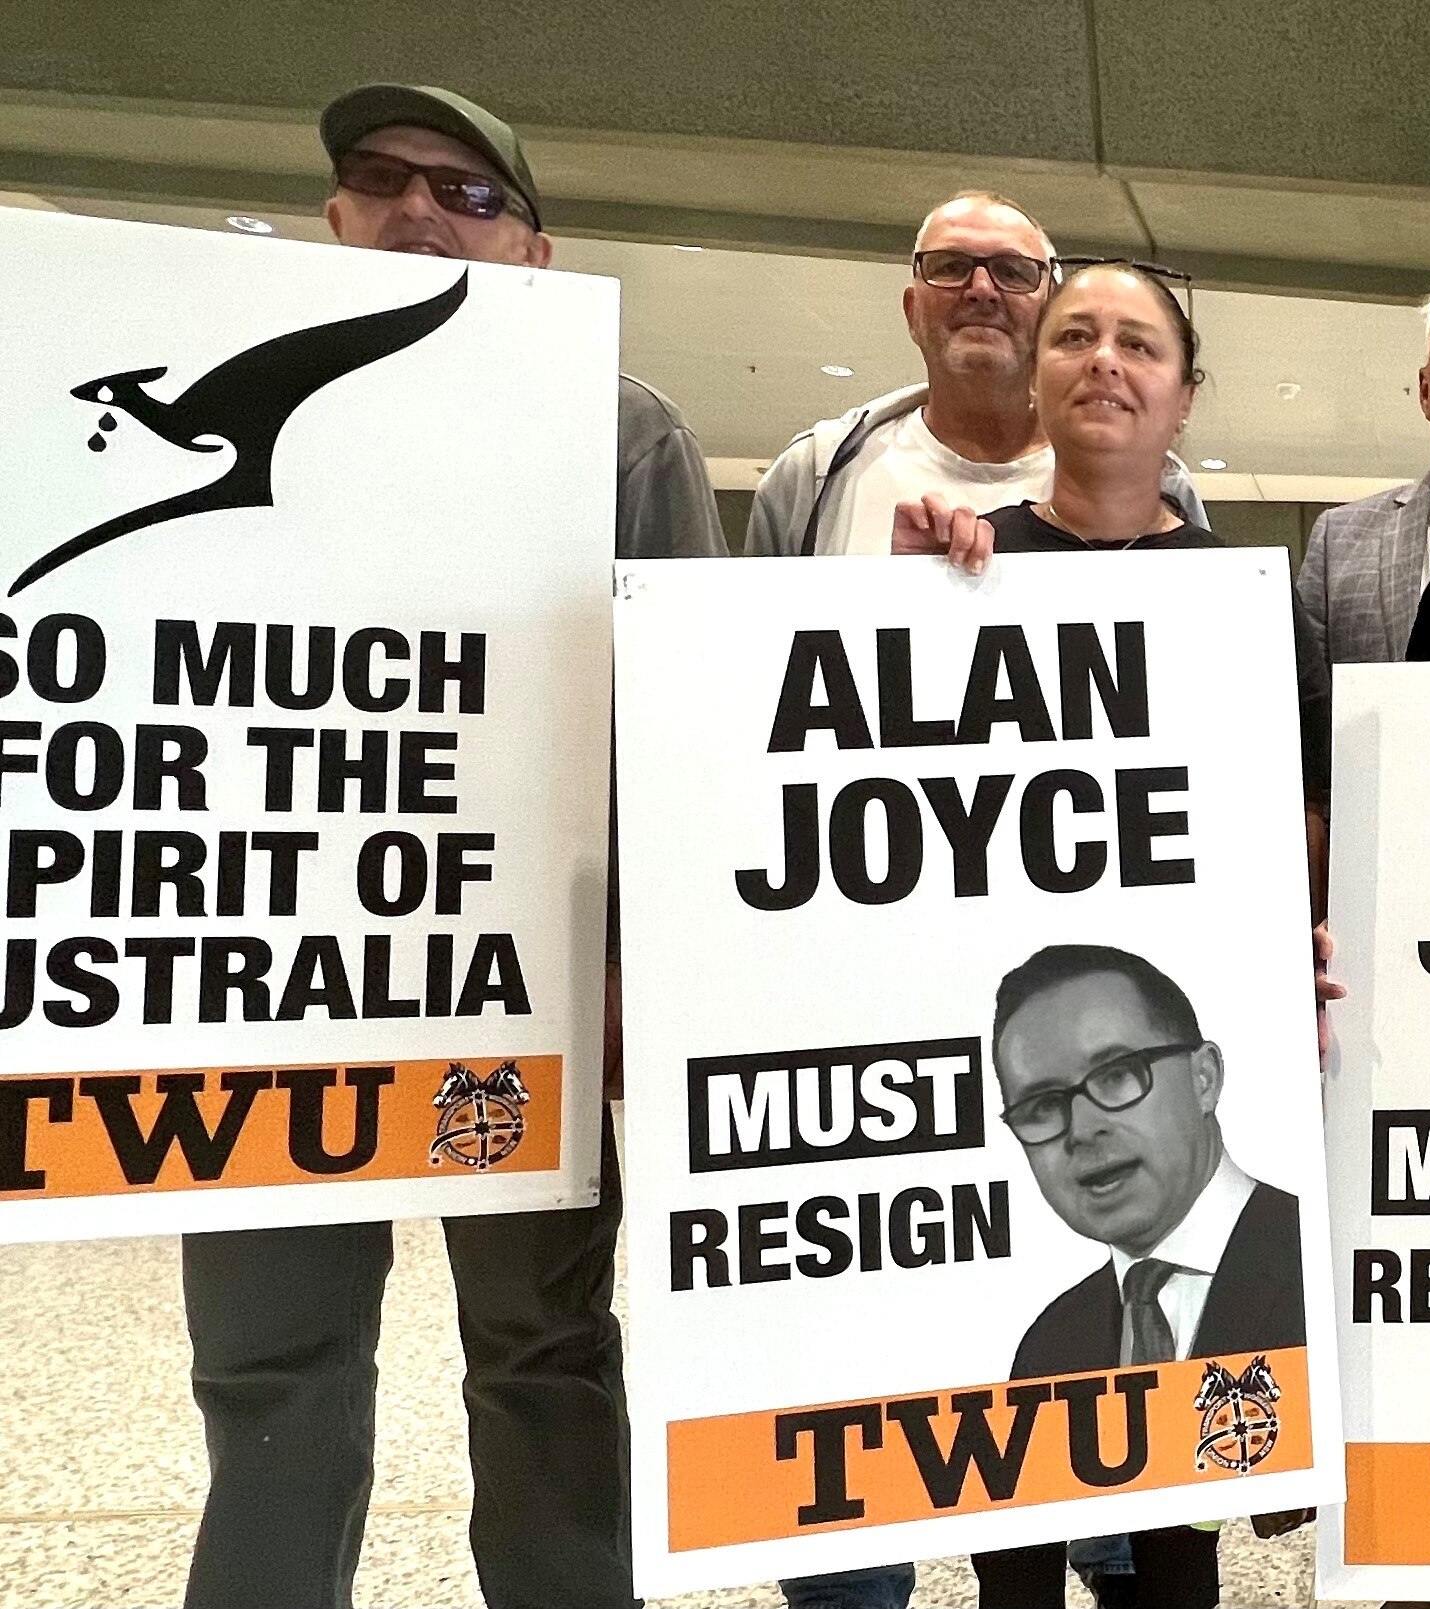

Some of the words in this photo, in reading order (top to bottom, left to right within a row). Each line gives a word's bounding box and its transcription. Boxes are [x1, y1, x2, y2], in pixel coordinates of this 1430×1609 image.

[0, 612, 107, 704] O
[152, 618, 487, 715] MUCH
[766, 621, 1150, 754] ALAN
[246, 726, 459, 814] THE
[6, 829, 319, 919] PIRIT
[356, 830, 496, 918] OF
[734, 765, 1196, 912] JOYCE
[0, 933, 533, 1030] STRALIA
[0, 1065, 396, 1192] TWU
[707, 1054, 971, 1156] MUST
[669, 1180, 1012, 1292] RESIGN
[775, 1370, 1159, 1527] TWU
